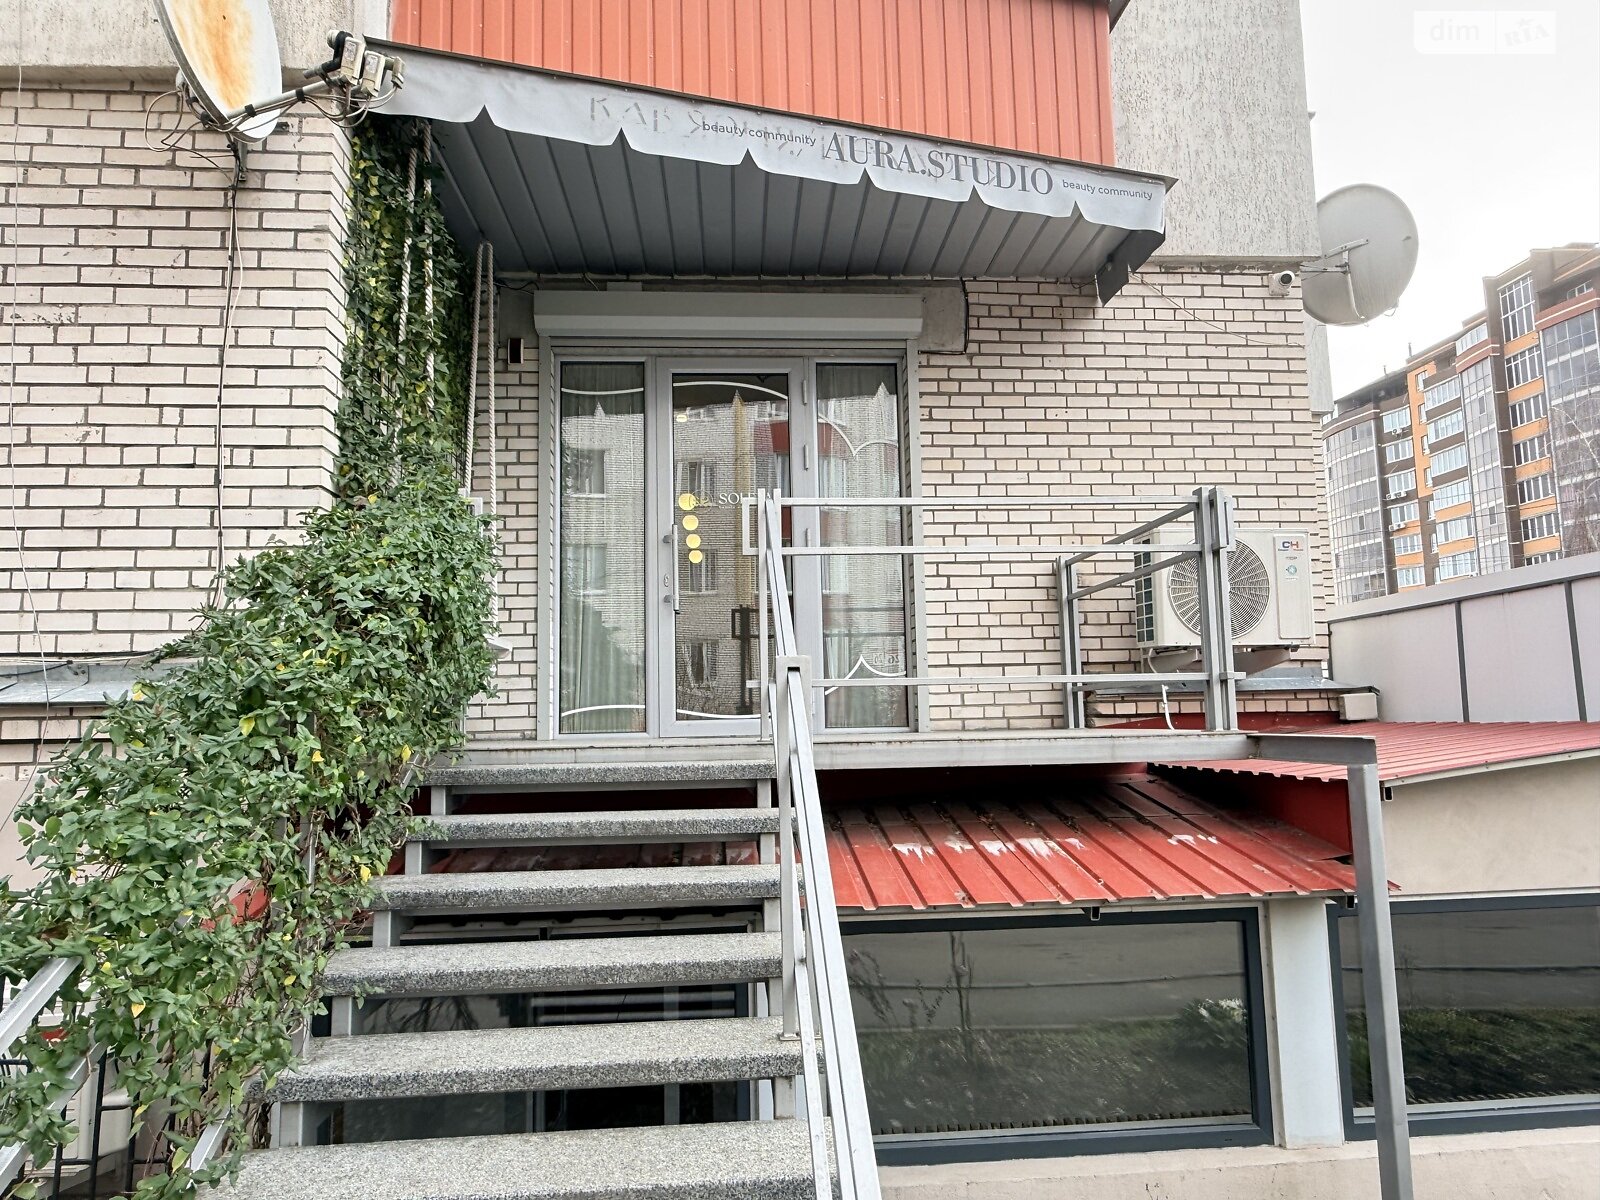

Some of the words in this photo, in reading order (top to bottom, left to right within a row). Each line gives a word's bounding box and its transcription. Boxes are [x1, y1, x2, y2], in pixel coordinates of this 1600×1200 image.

[702, 121, 745, 137] beauty
[748, 128, 817, 147] community
[823, 131, 1054, 196] AURA.STUDIO
[1062, 179, 1096, 195] beauty
[1098, 186, 1153, 201] community
